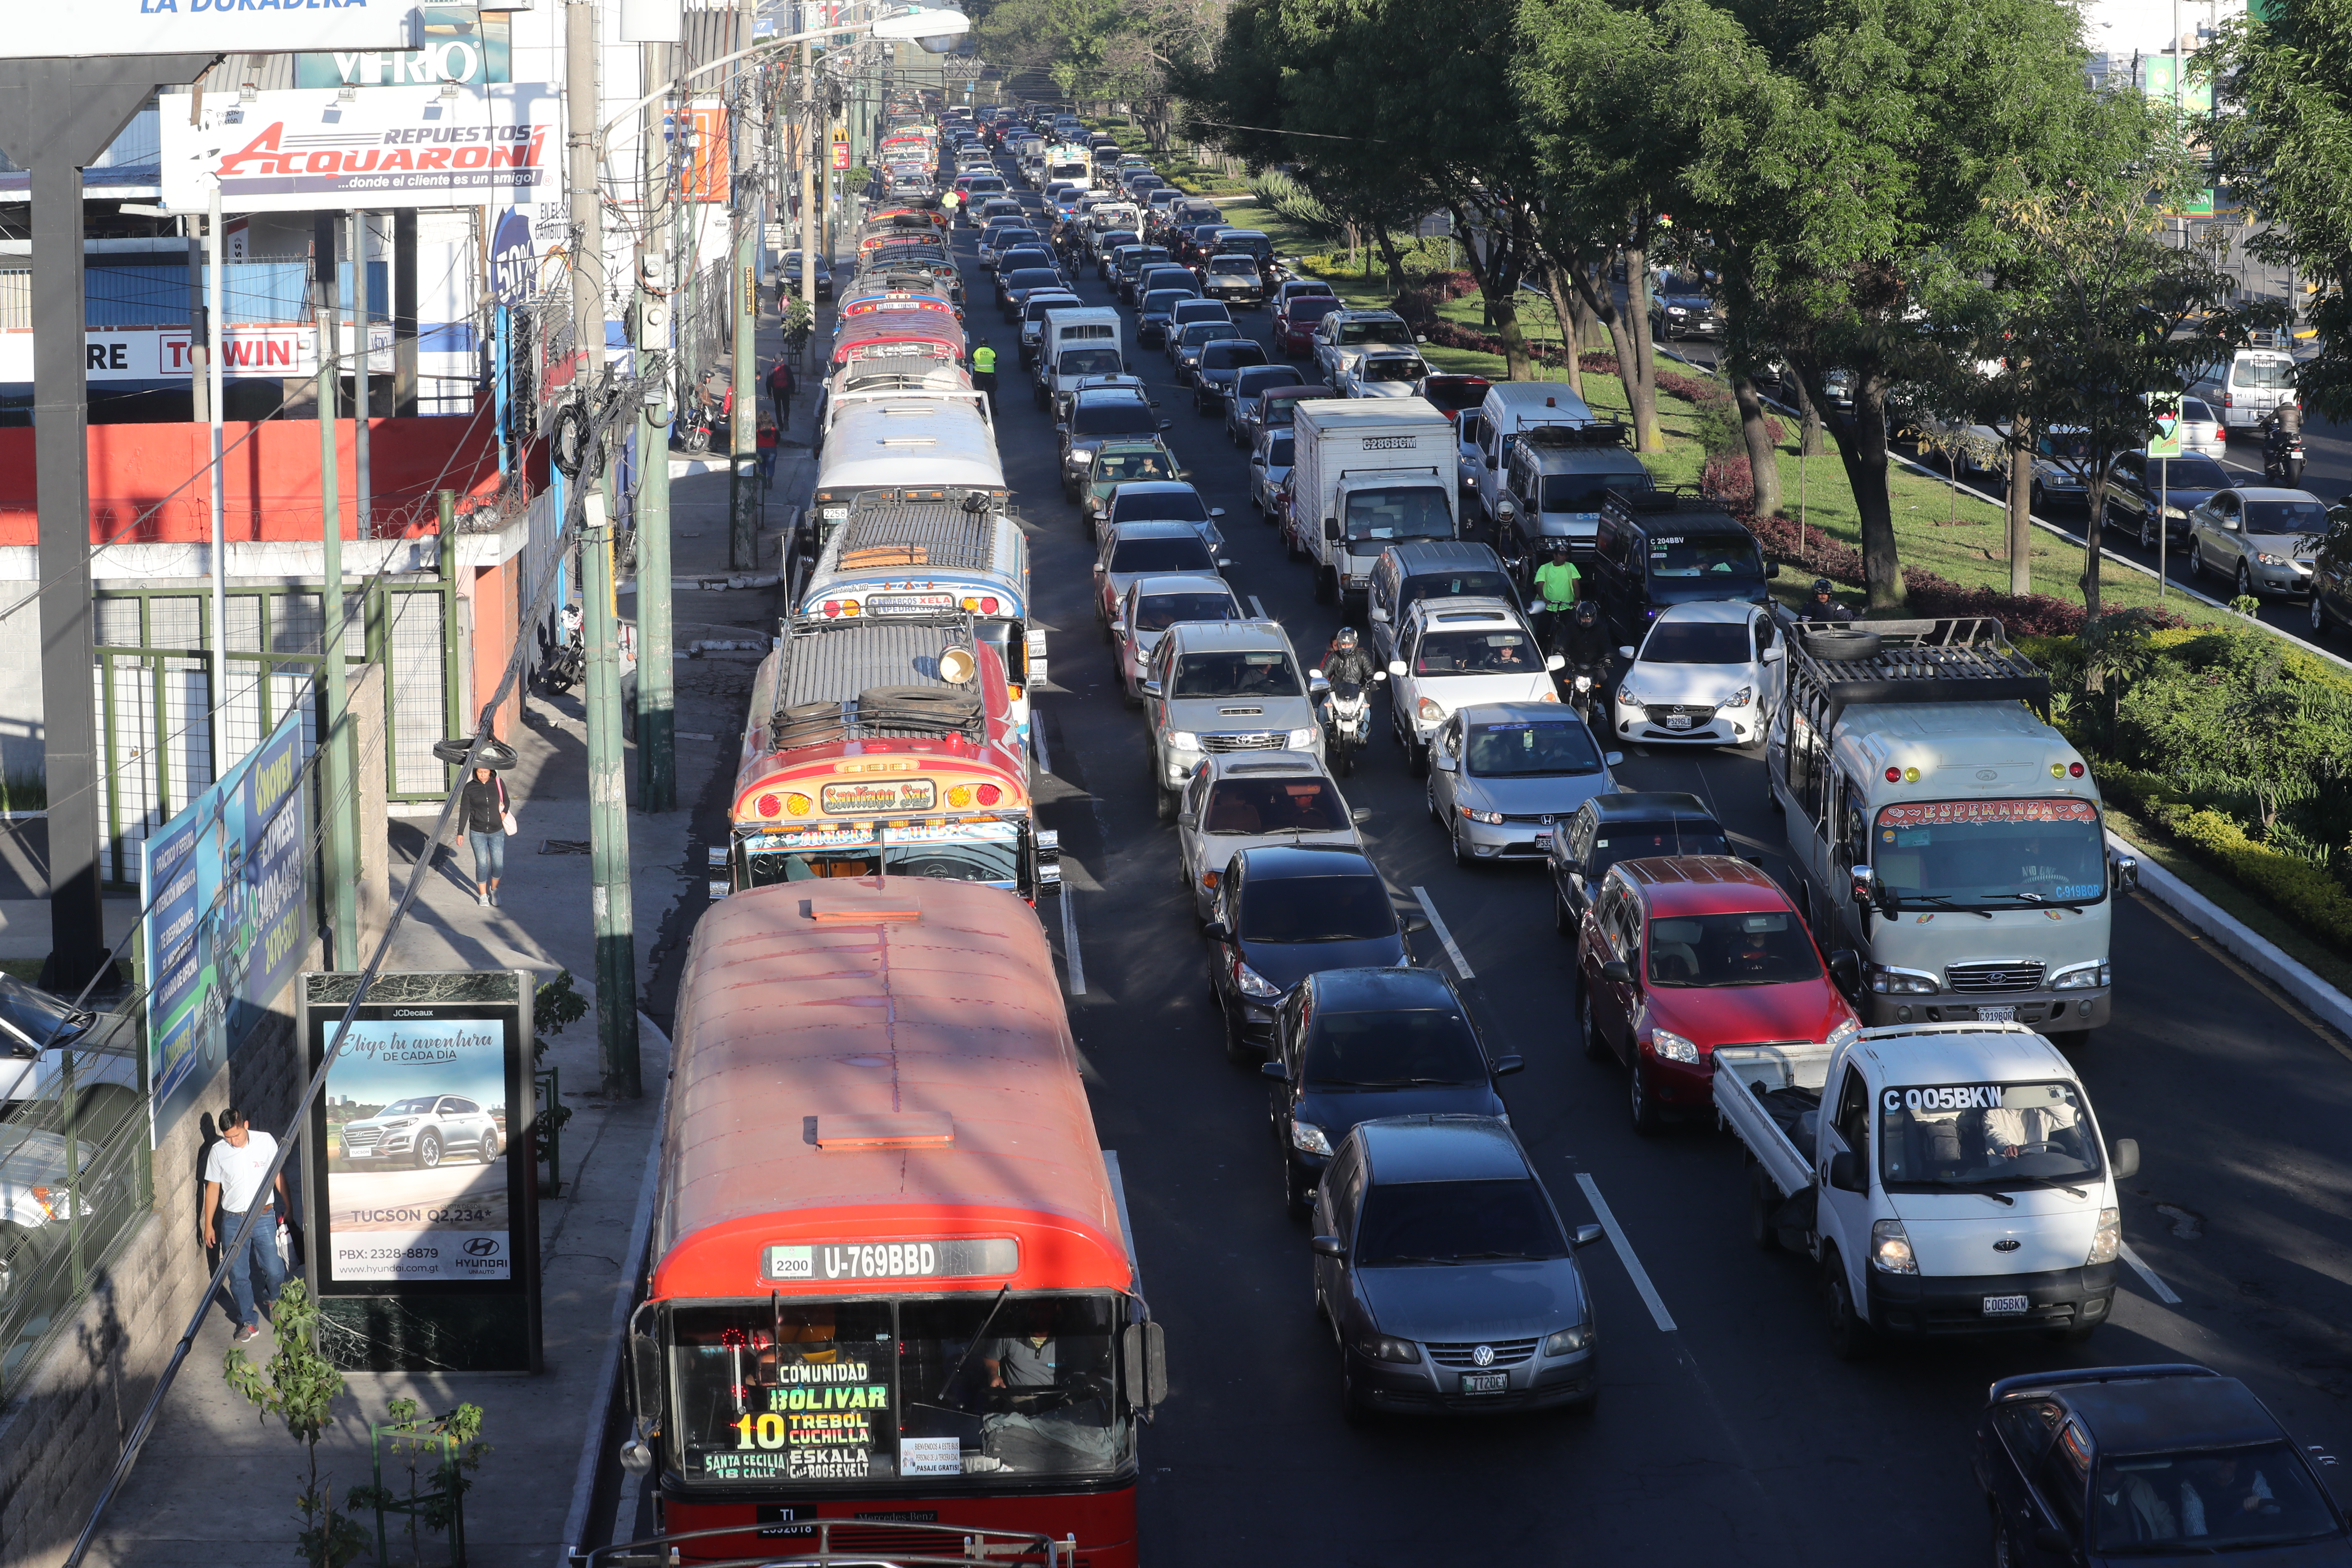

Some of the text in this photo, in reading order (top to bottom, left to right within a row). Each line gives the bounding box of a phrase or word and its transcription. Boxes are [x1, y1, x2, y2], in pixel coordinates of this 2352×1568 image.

[384, 125, 532, 144] REPUESTOS
[392, 175, 404, 187] el
[407, 174, 450, 186] cliente
[453, 177, 469, 185] es
[472, 175, 488, 184] un
[493, 171, 536, 186] amigo!
[496, 240, 536, 303] 50%
[222, 340, 290, 366] WIN
[1363, 437, 1416, 450] C286BCM
[1923, 802, 2055, 818] ESPERANZA
[262, 796, 295, 868] EXPRESS
[156, 830, 194, 875] PRÁCTICO Y SEGURO
[156, 867, 196, 917] ATENCIÓN INMEDIATA
[258, 846, 300, 932] 3400-0019
[2056, 885, 2101, 898] C-919BQR
[160, 906, 194, 951] TE DESPACHAMOS
[266, 903, 300, 975] 2470-5200
[159, 955, 198, 1007] HORARIO DE OFICINA
[1980, 1011, 2012, 1021] C919BQR
[337, 1029, 493, 1060] Elige tu aventura
[383, 1047, 457, 1061] DE CADA DÍA
[1884, 1086, 2002, 1110] C 005BKW
[351, 1209, 421, 1223] TUCSON
[339, 1248, 439, 1259] PBX: 2328-8879
[824, 1243, 935, 1279] U-769BBD
[339, 1264, 439, 1275] www.hyundai.com.gt
[456, 1259, 508, 1268] HYUNDAI
[776, 1260, 808, 1271] 2200
[1985, 1297, 2026, 1311] C005BKW
[779, 1363, 867, 1384] COMUNIDAD
[769, 1386, 887, 1411] BOLIVAR
[789, 1413, 869, 1429] TREBOL
[736, 1413, 785, 1450] 10
[789, 1428, 870, 1444] CUCHILLA
[706, 1454, 785, 1472] SANTA CECILIA
[790, 1449, 868, 1464] ESKALA
[716, 1467, 776, 1479] 18 CALLE
[808, 1463, 869, 1479] ROOSEVELT
[915, 1464, 937, 1473] ¡PASAJE
